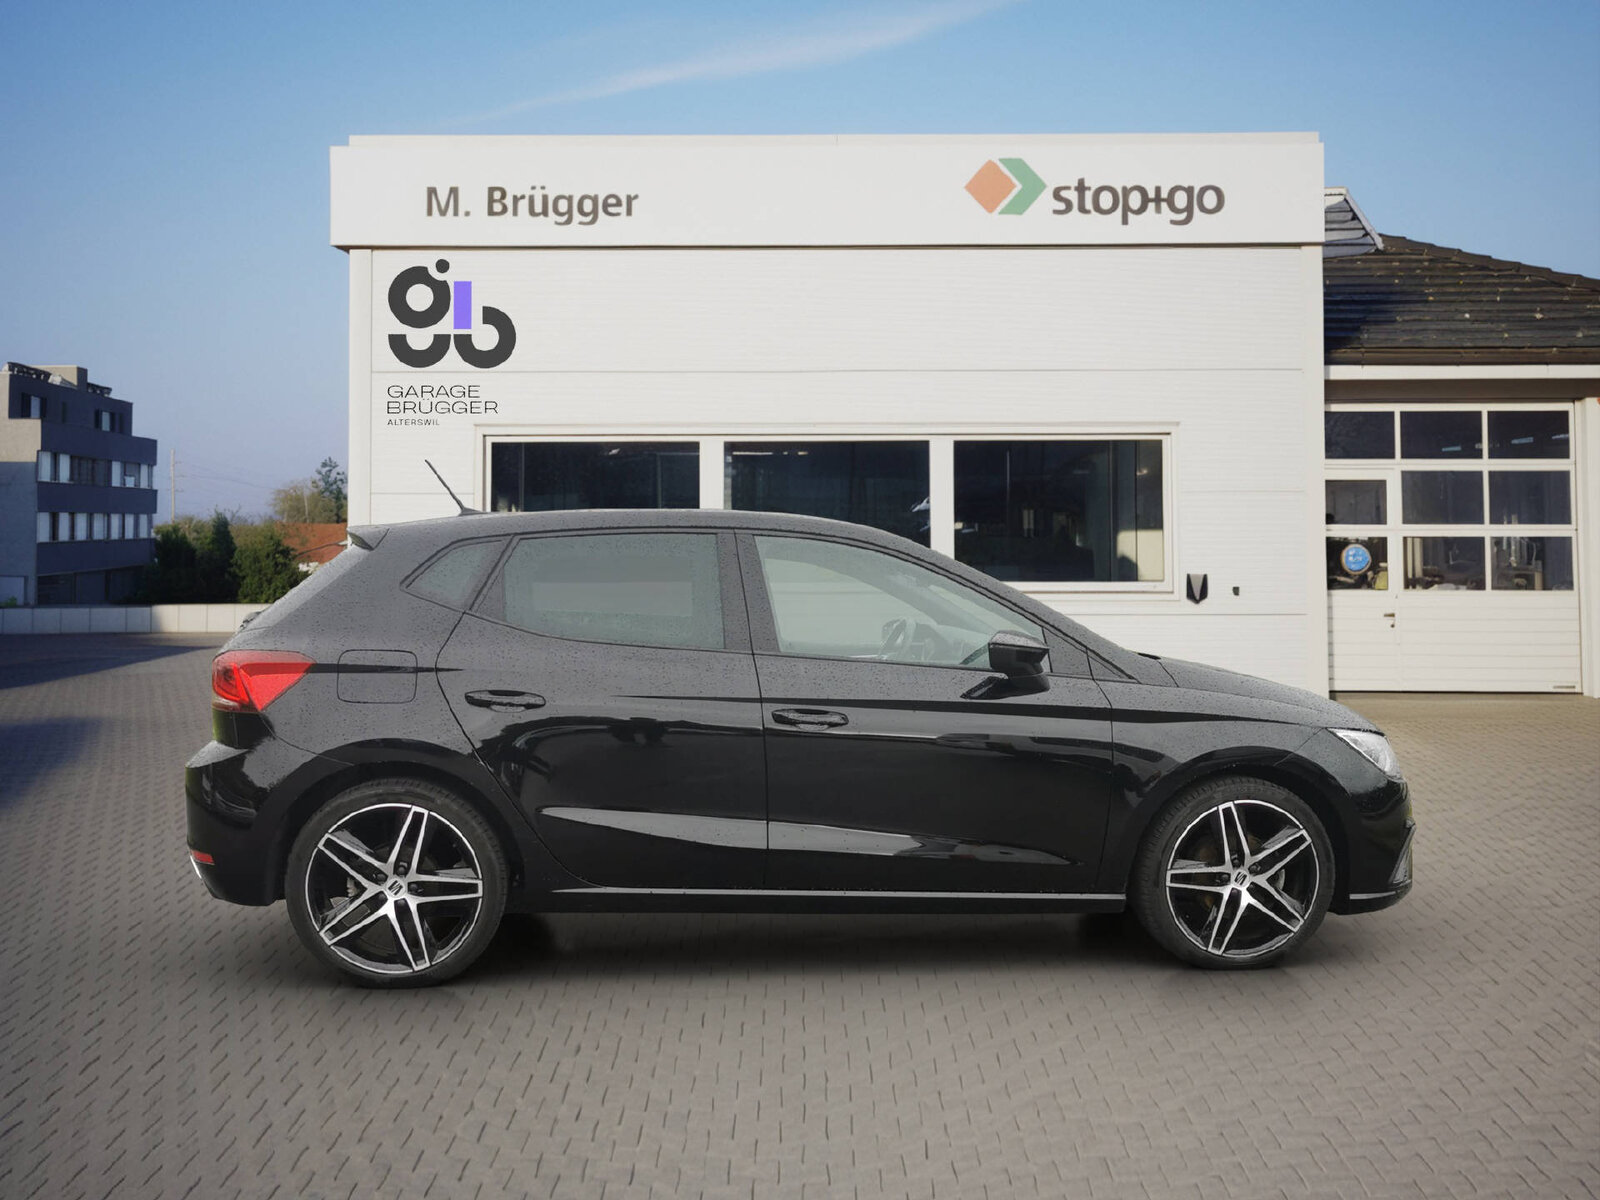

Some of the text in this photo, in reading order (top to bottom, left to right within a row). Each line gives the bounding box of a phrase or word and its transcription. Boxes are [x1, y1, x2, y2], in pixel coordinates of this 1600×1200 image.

[426, 185, 639, 226] M. Brügger
[1052, 177, 1226, 226] stop+go
